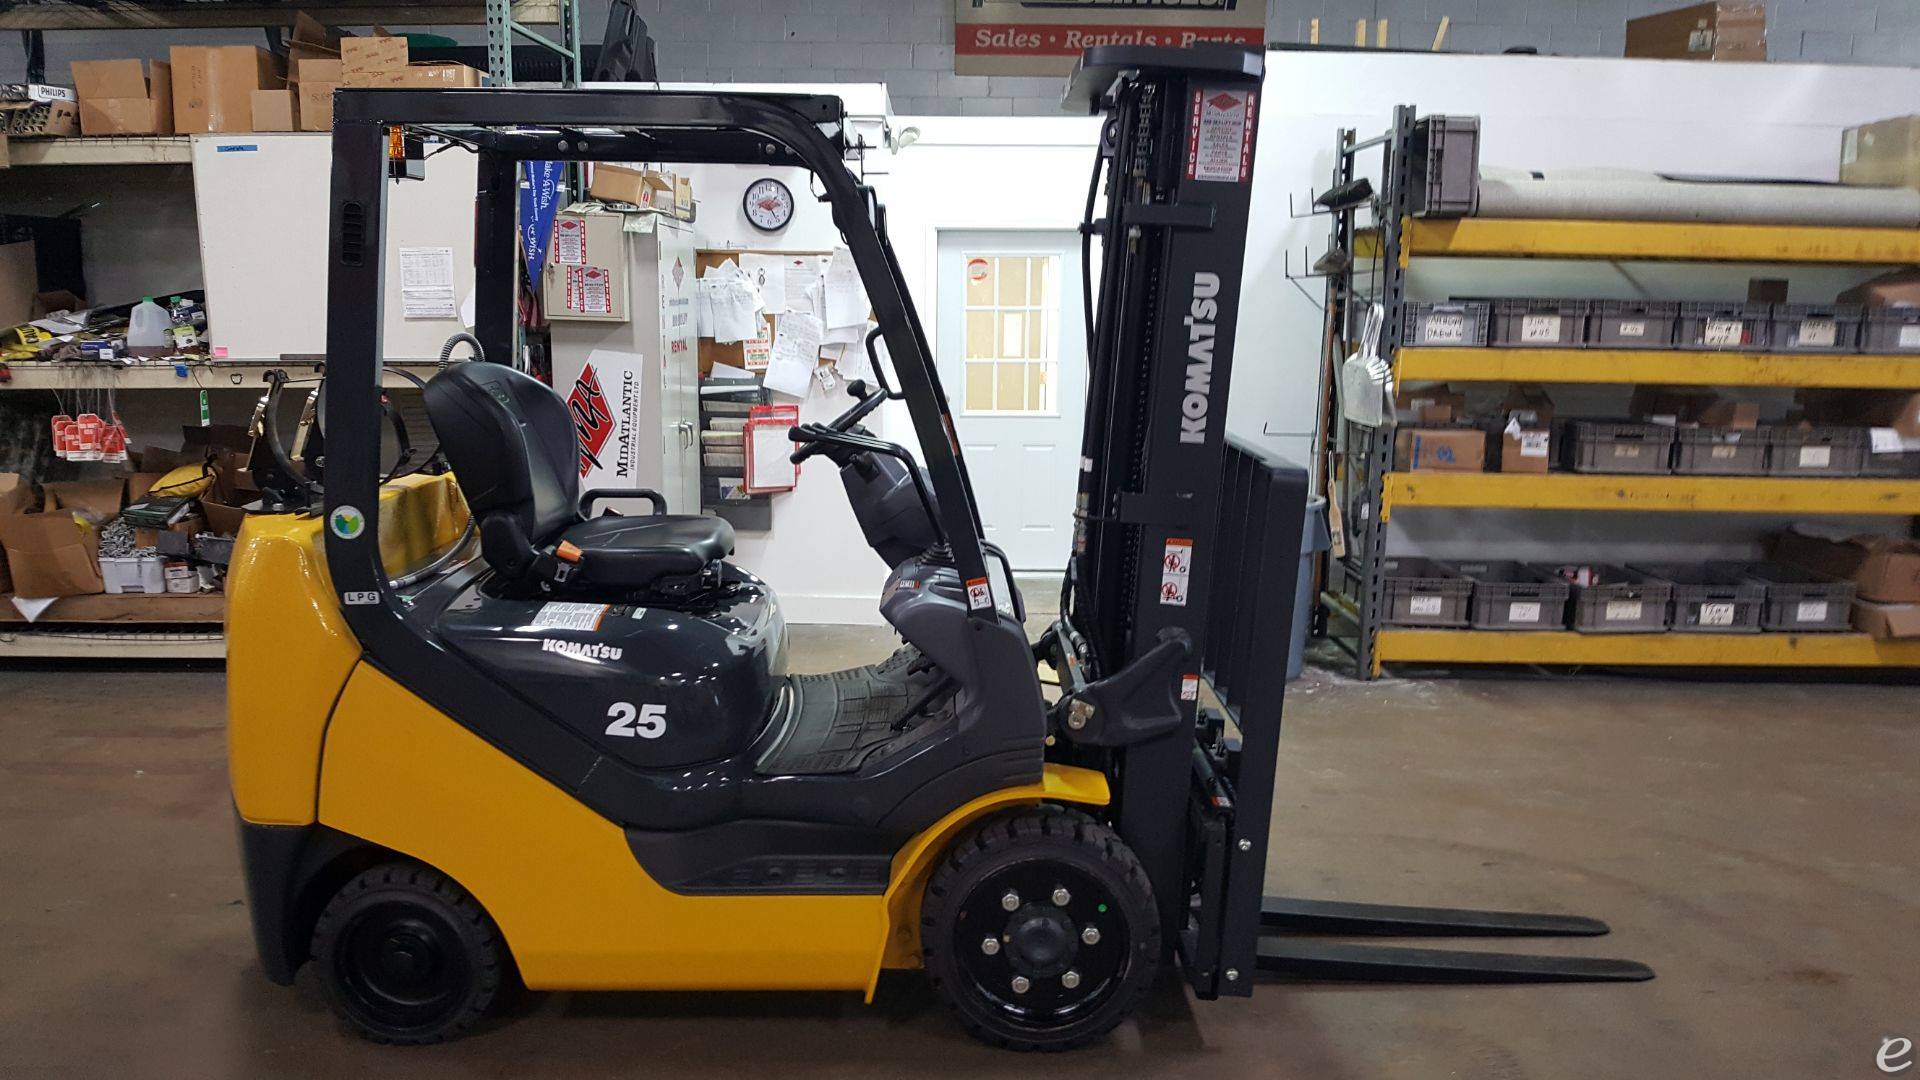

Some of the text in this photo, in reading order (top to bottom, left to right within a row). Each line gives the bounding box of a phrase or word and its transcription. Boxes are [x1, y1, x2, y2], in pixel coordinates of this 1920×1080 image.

[975, 28, 1041, 48] Sales
[1064, 30, 1157, 48] Rentals
[41, 87, 66, 97] PHILIPS
[1241, 95, 1254, 178] RENTALS
[671, 338, 688, 353] RENTAL
[1180, 272, 1221, 444] KOMATSU
[630, 433, 638, 471] INDUSTRIAL
[542, 638, 623, 660] KOMATSU
[605, 701, 667, 739] 25
